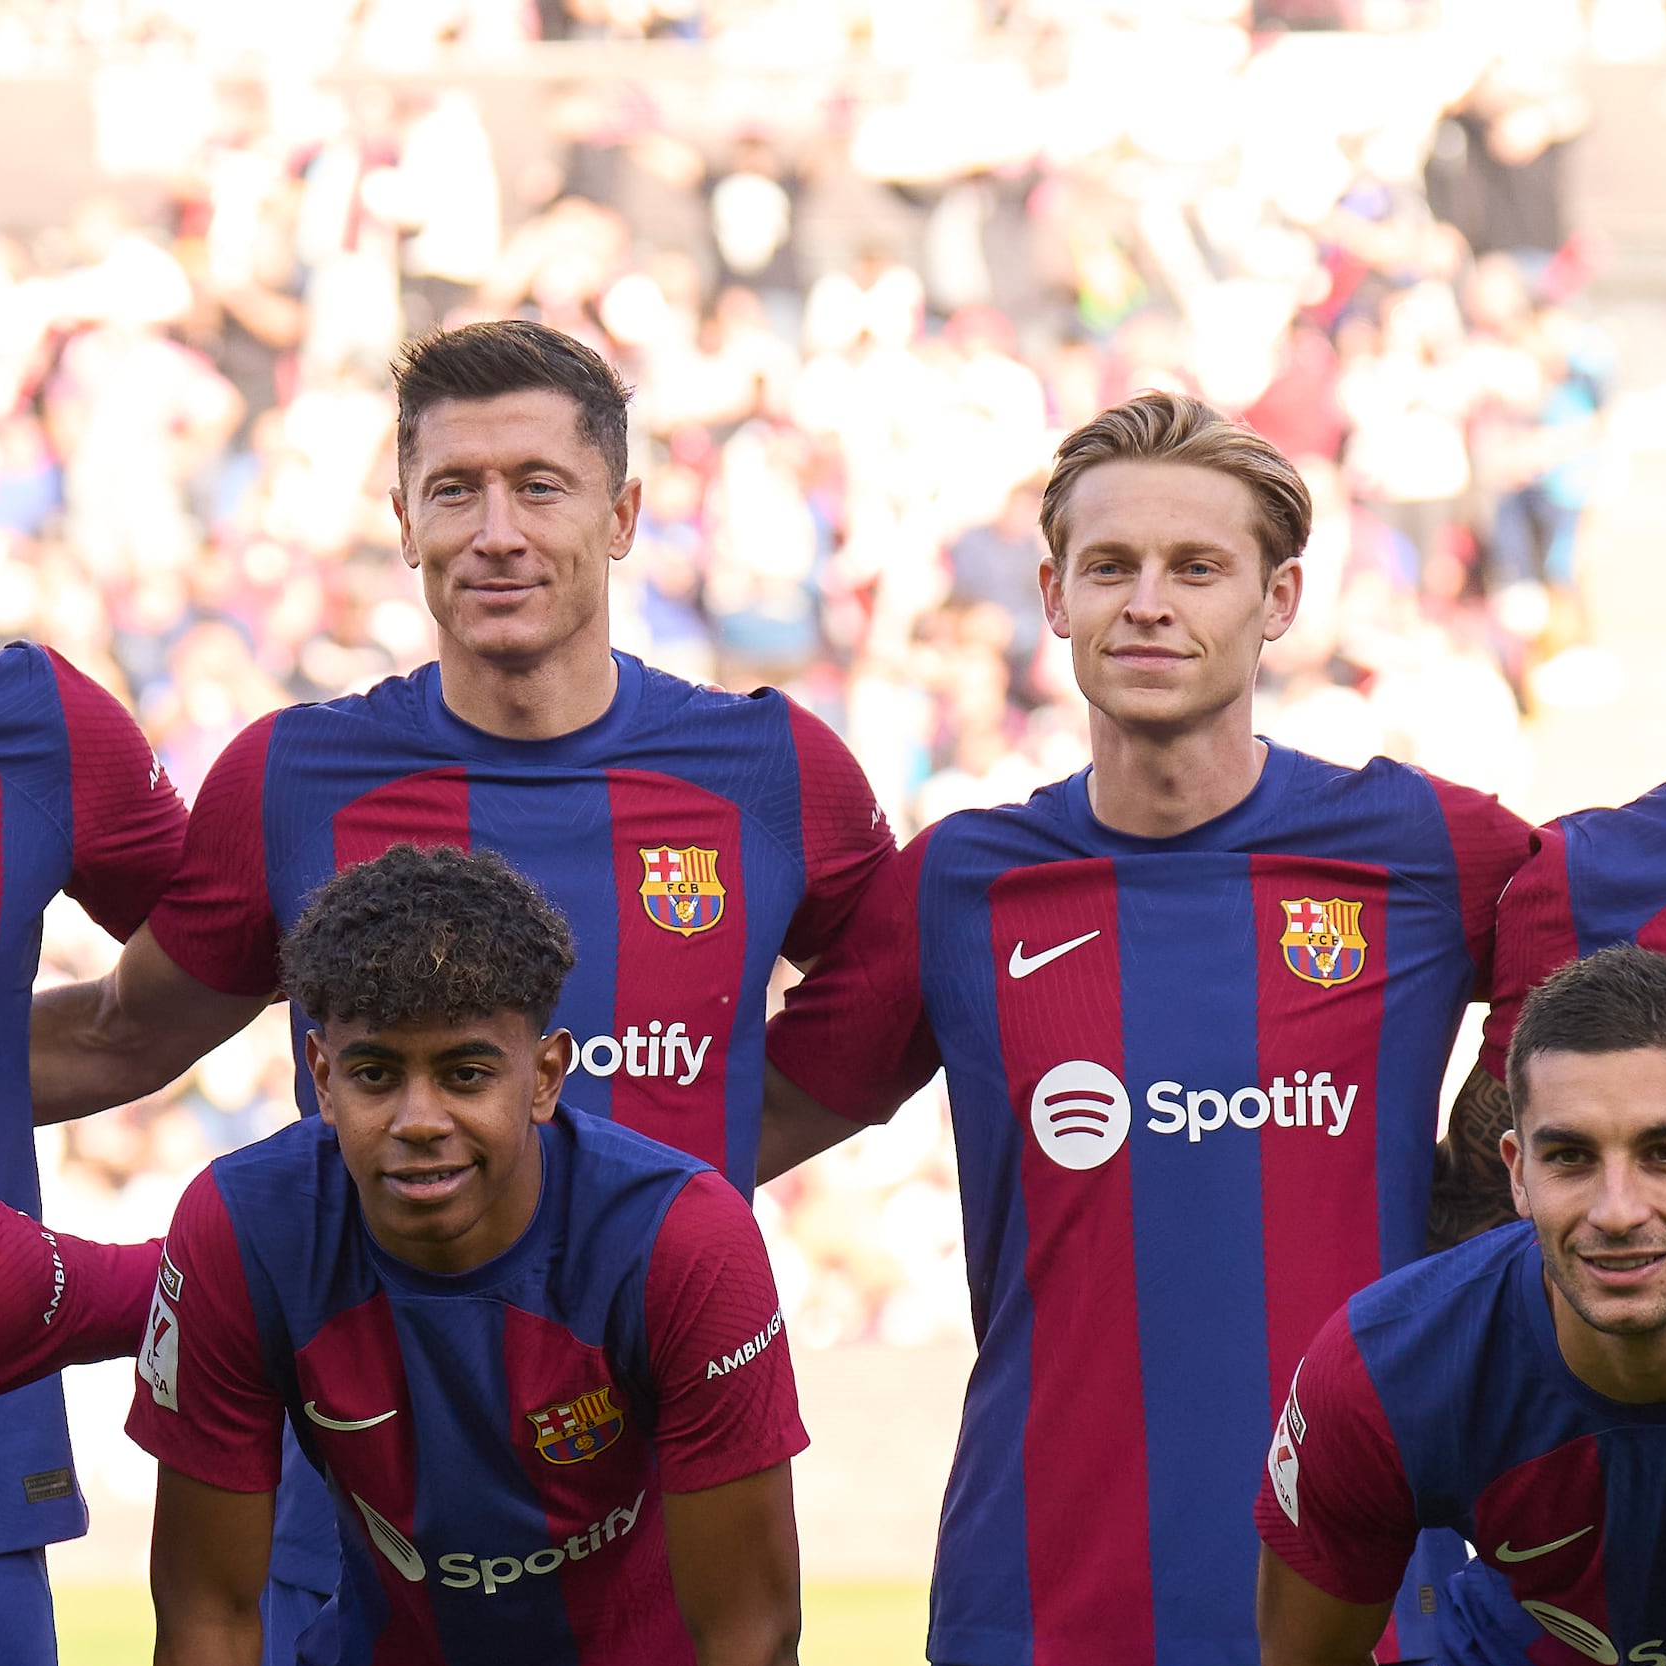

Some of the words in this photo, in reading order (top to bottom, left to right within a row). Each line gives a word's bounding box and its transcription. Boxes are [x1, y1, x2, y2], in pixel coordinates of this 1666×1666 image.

[667, 883, 699, 893] FCB
[1146, 1069, 1359, 1143] Spotify
[562, 1420, 596, 1438] FCB
[438, 1488, 646, 1595] Spotify
